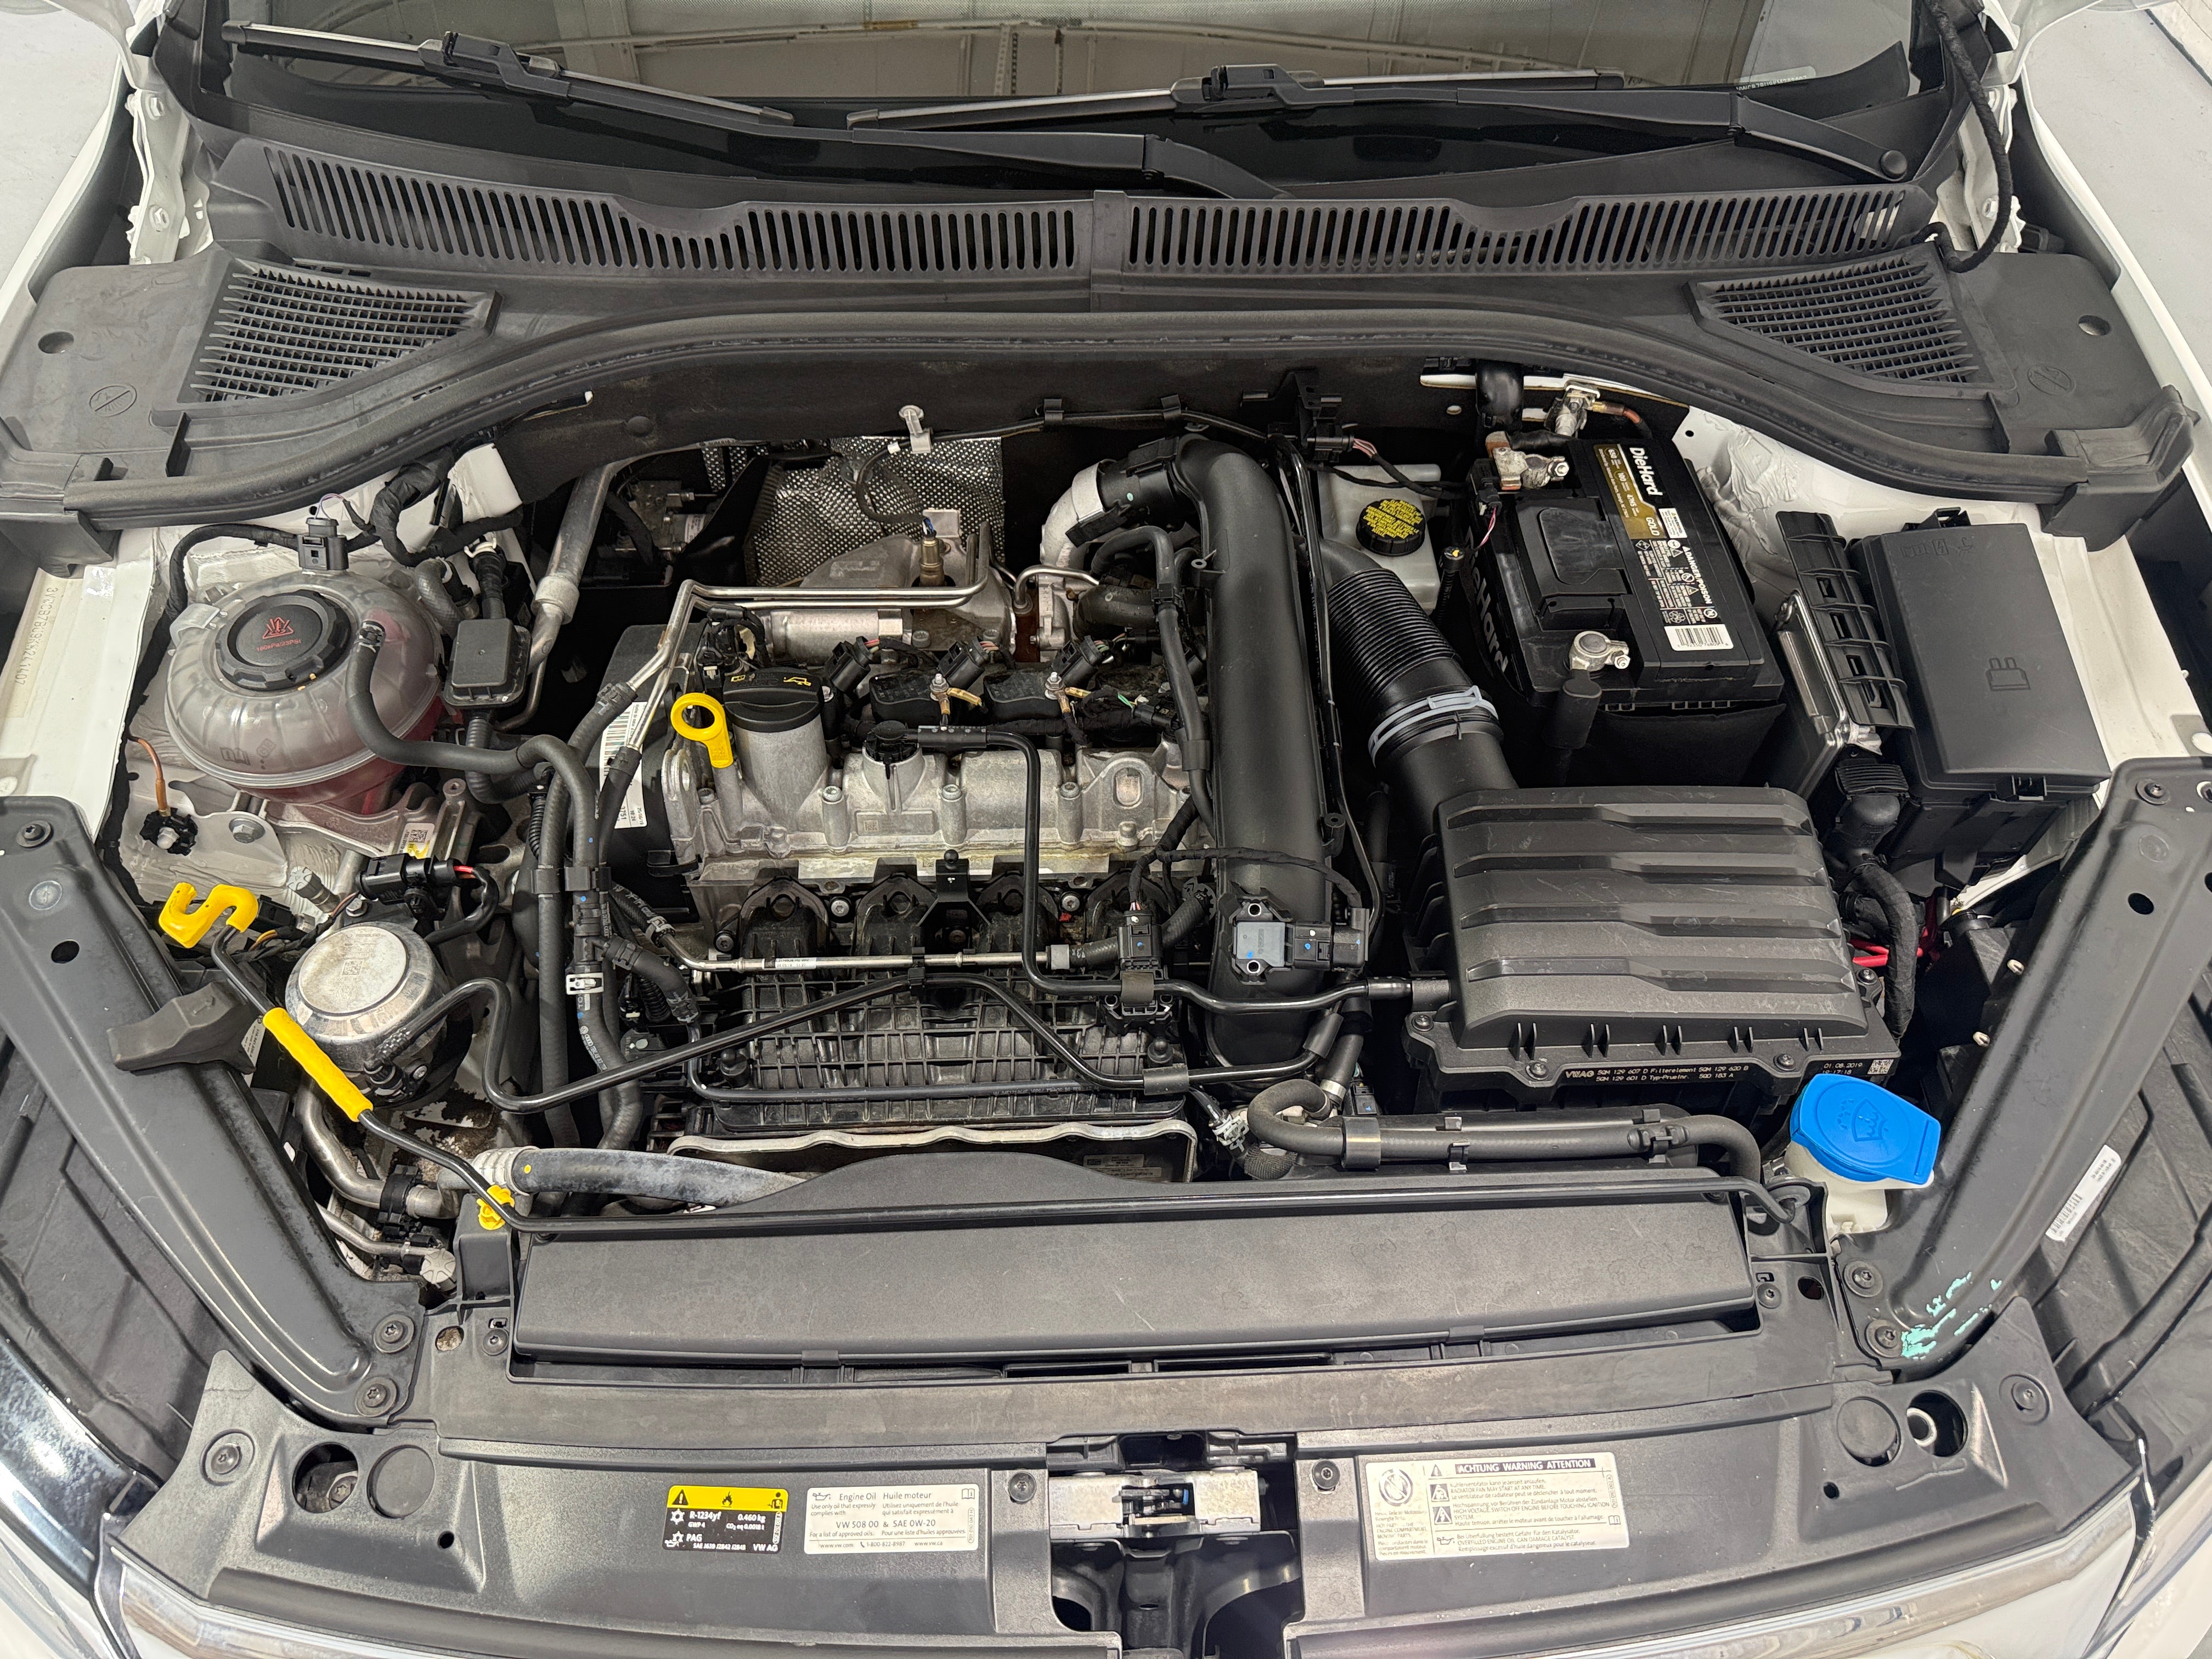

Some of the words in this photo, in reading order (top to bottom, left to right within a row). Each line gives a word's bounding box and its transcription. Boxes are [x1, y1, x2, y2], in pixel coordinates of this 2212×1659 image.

[1608, 448, 1617, 459] 650
[1617, 472, 1627, 482] 100
[1629, 447, 1663, 496] DieHard
[1646, 517, 1660, 536] GOLD
[1458, 1463, 1500, 1473] ACHTUNG
[1502, 1462, 1543, 1471] WARNING
[1547, 1459, 1591, 1469] ATTENTION
[839, 1492, 865, 1503] Engine
[866, 1492, 876, 1500] Oil
[883, 1491, 902, 1499] Huile
[852, 1502, 876, 1511] expressly
[689, 1511, 722, 1522] R-1234yf
[757, 1514, 766, 1523] kg
[686, 1533, 703, 1542] PAG
[766, 1544, 778, 1552] AG
